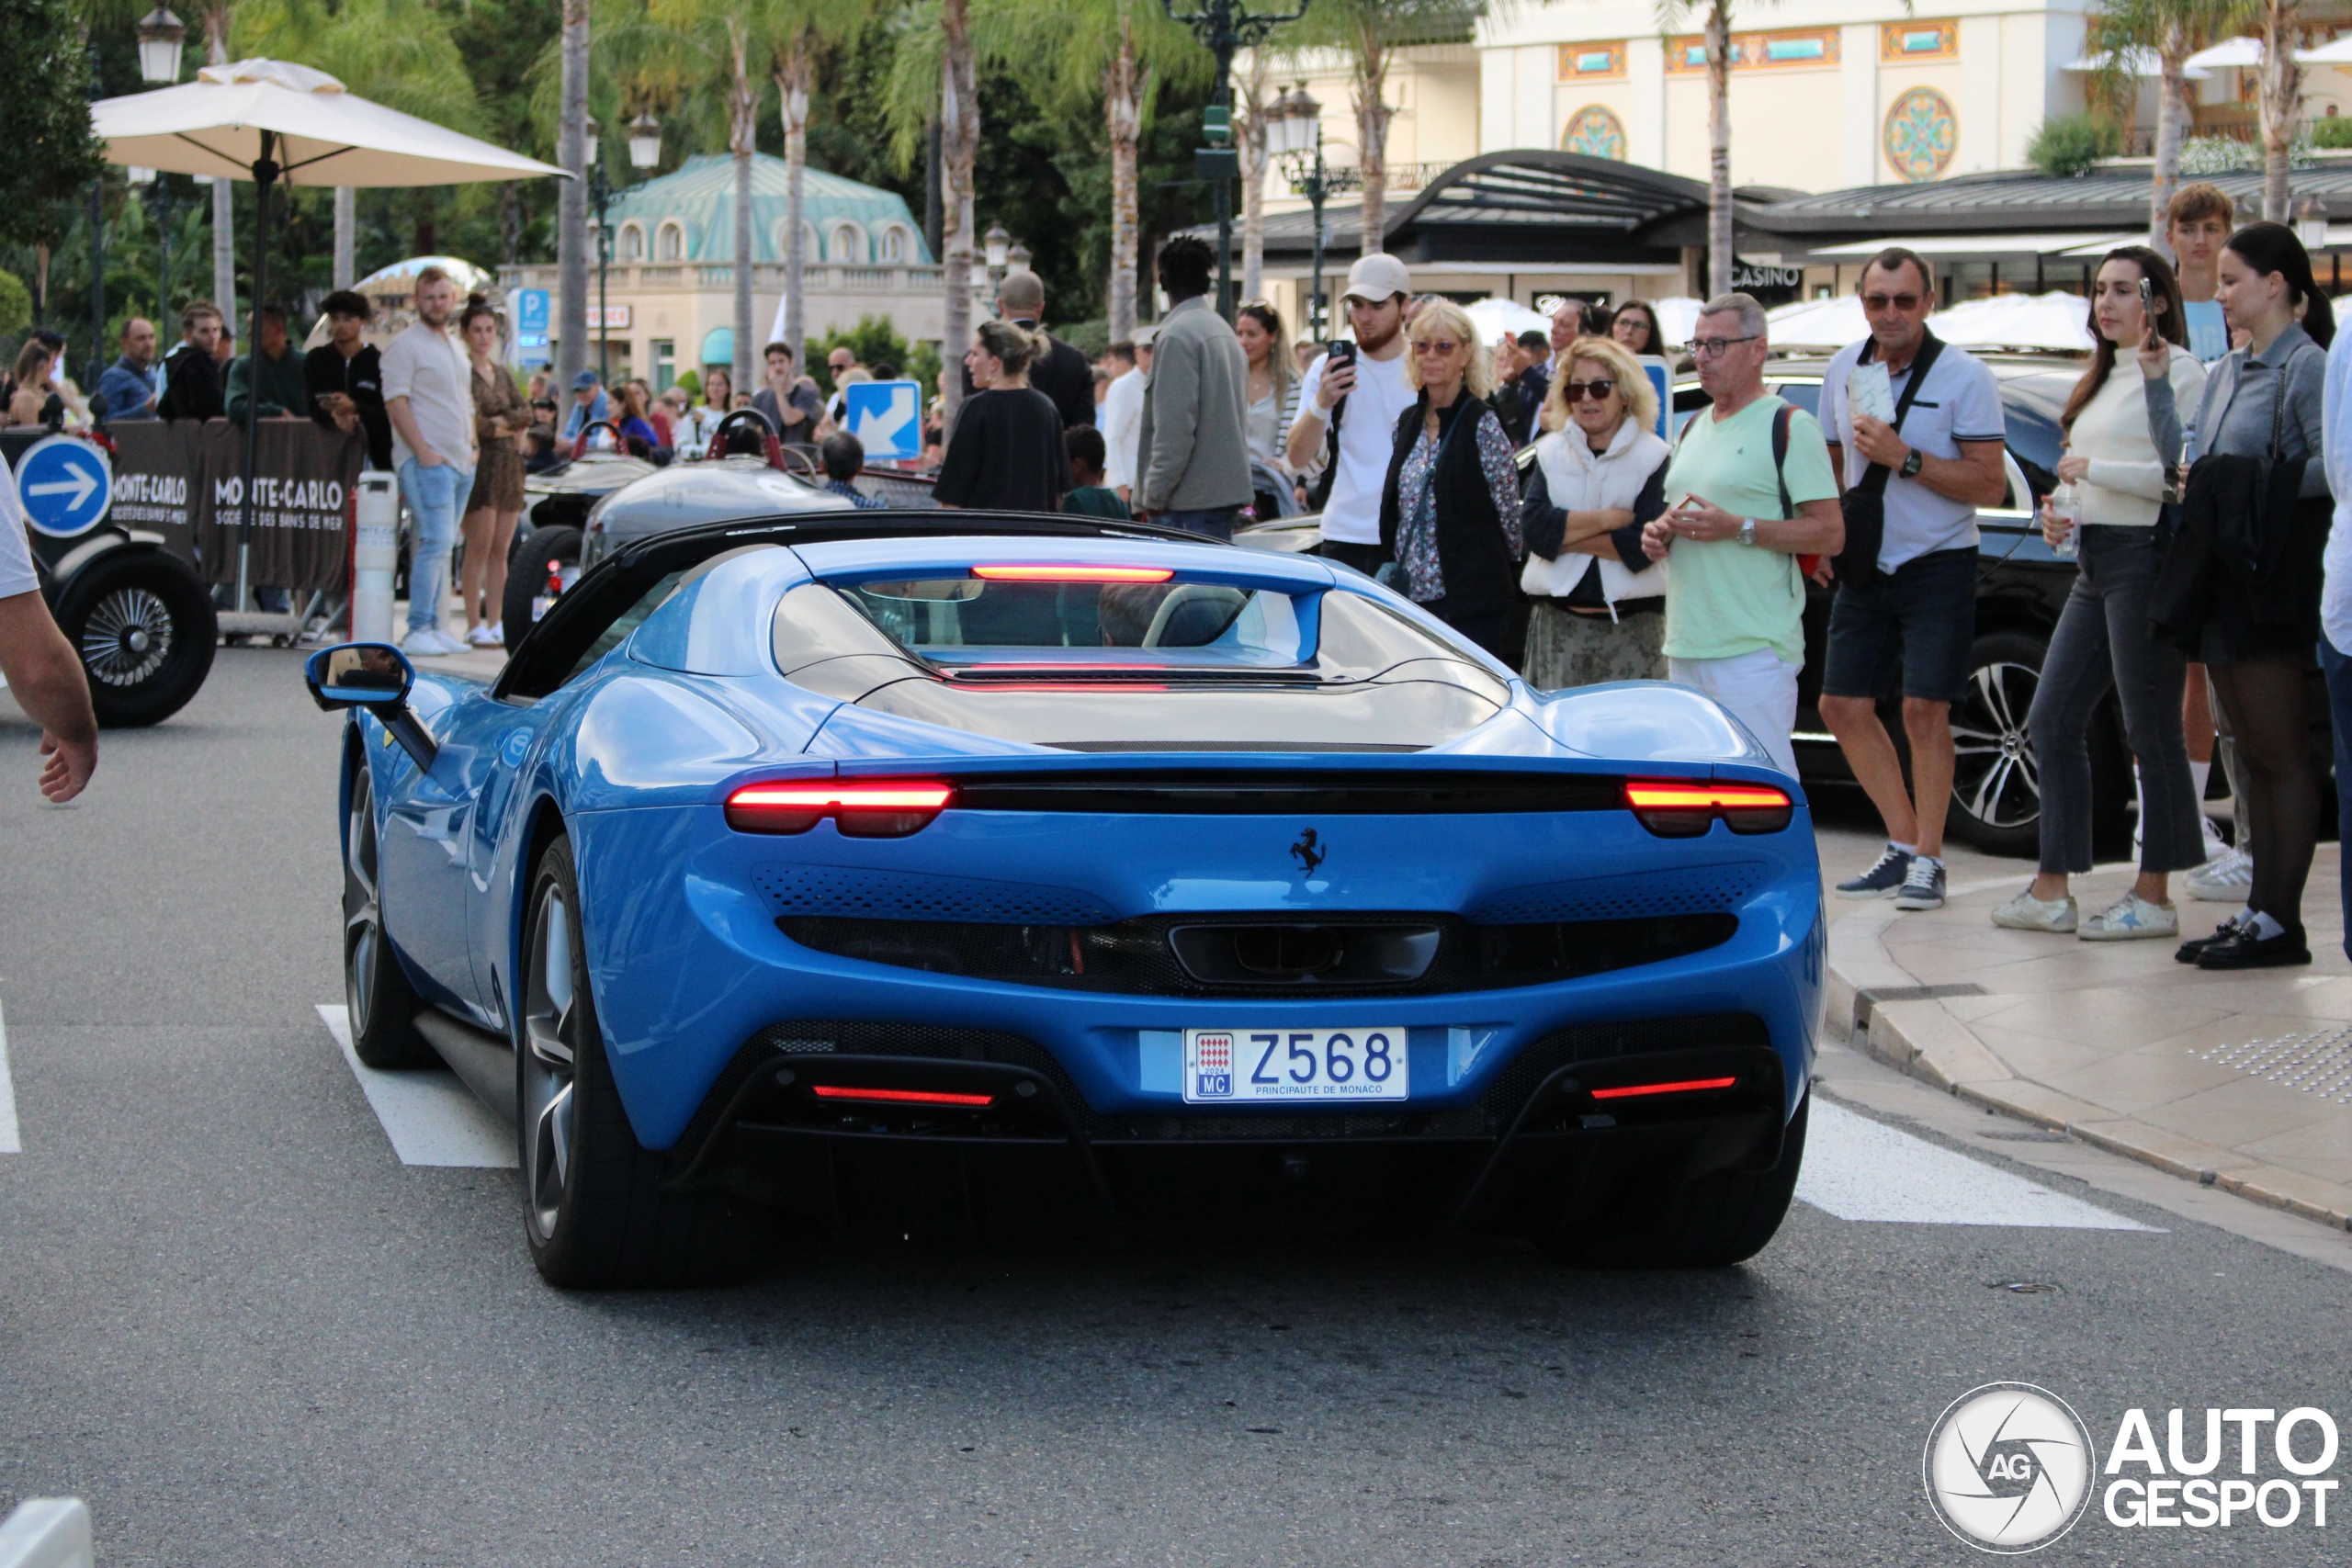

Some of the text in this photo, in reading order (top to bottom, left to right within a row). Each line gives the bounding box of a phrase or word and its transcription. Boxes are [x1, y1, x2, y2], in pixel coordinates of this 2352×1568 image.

[1730, 266, 1799, 288] CASINO
[525, 293, 540, 318] P
[258, 511, 276, 526] DES
[309, 513, 321, 529] DE
[322, 515, 343, 531] MER
[1250, 1032, 1392, 1084] Z568
[1204, 1077, 1226, 1093] MC
[1255, 1085, 1383, 1095] PRINCIPAUTE DE MONACO
